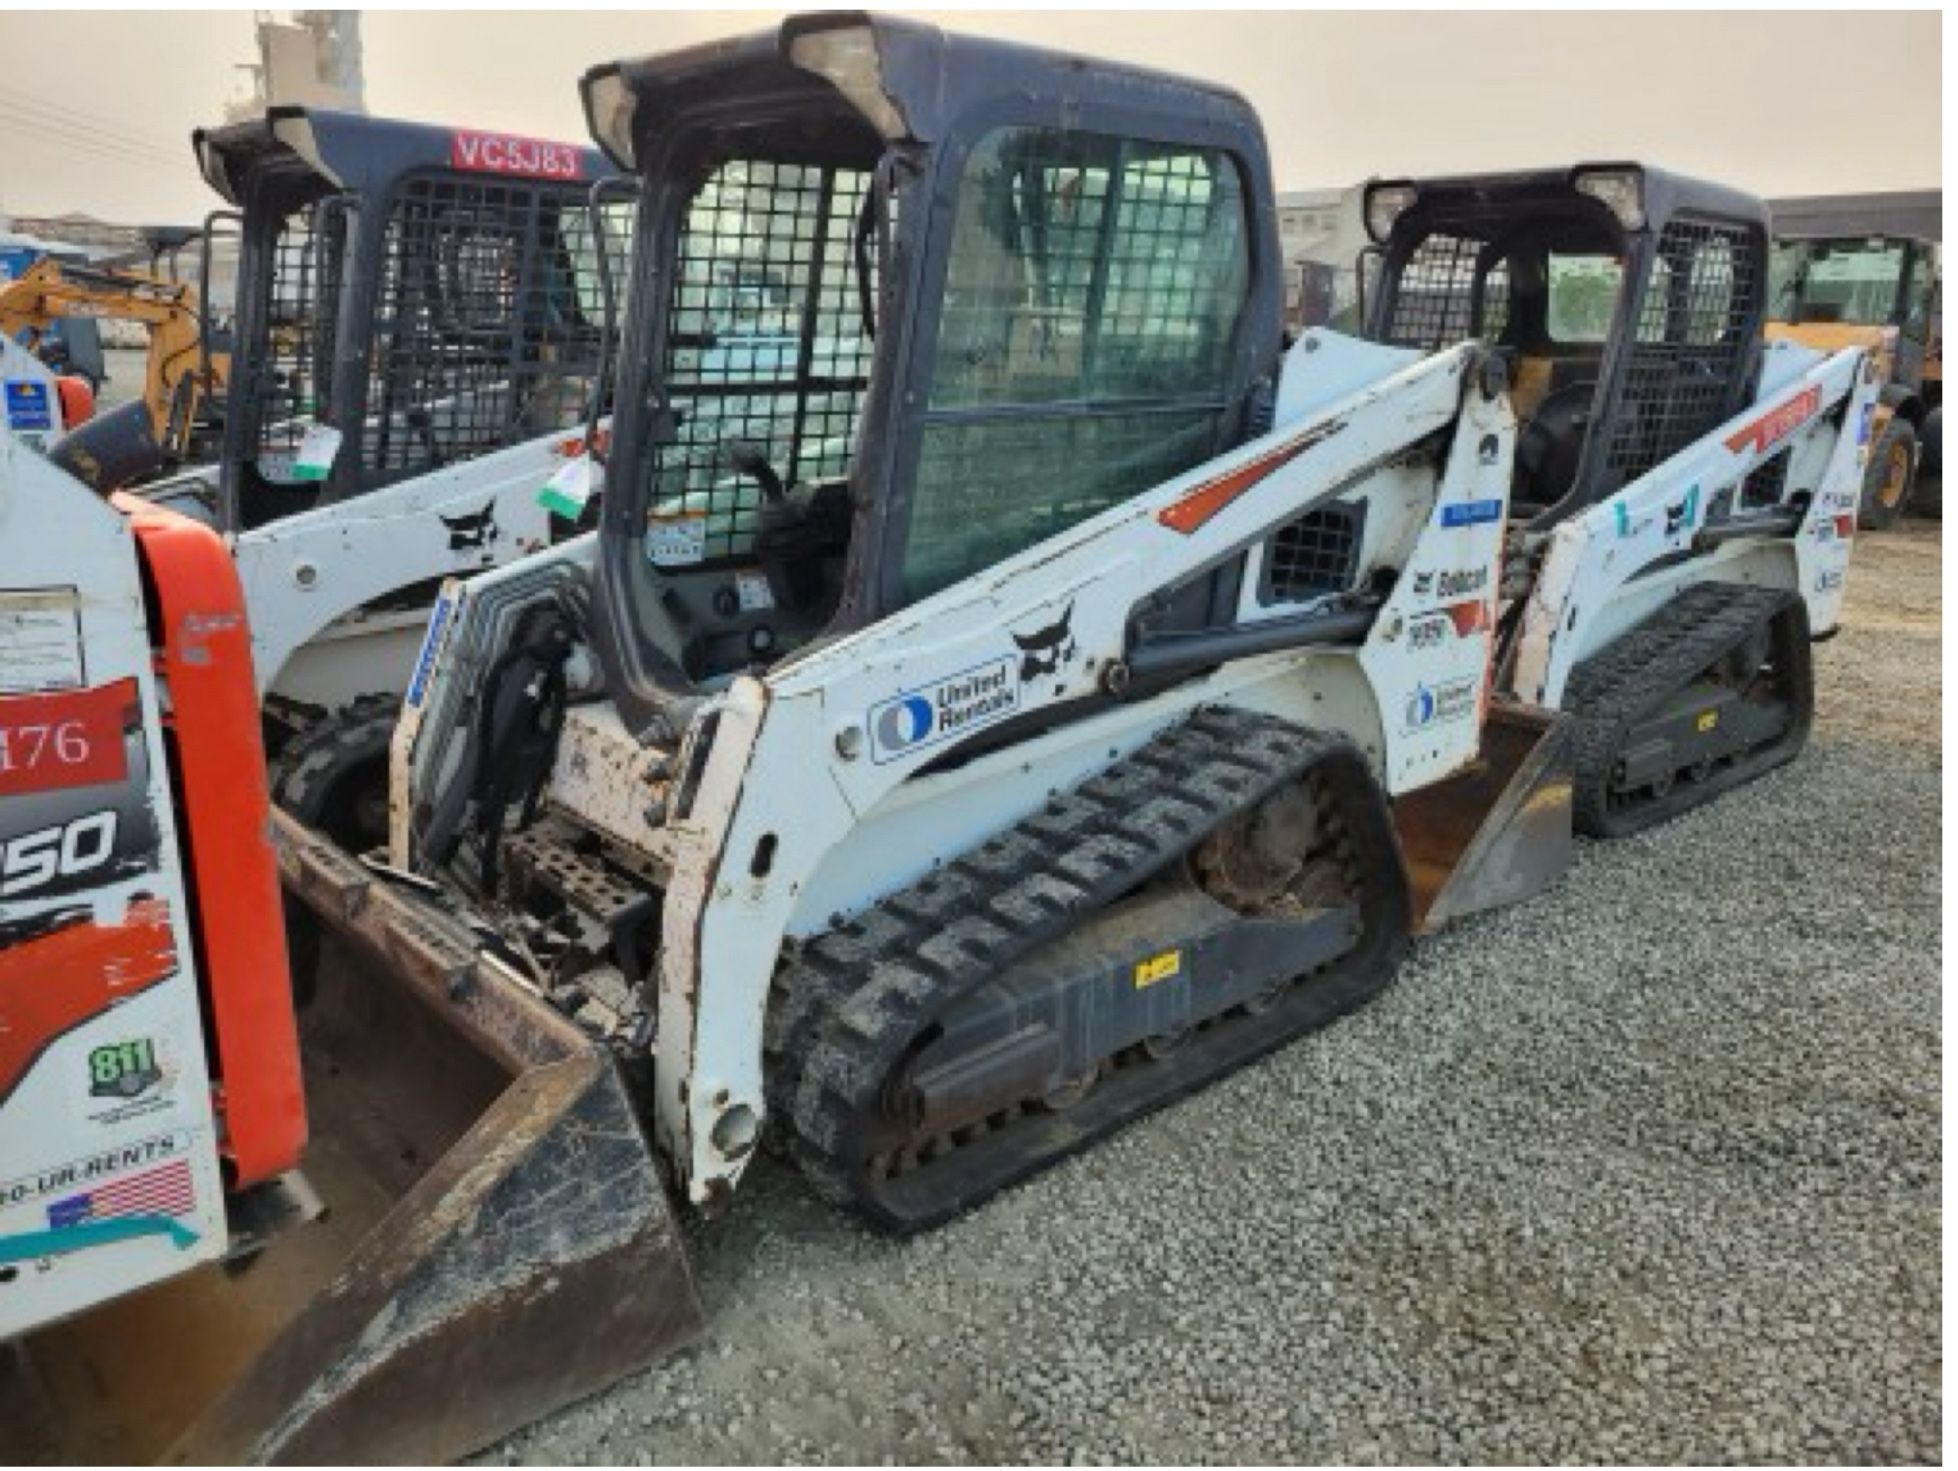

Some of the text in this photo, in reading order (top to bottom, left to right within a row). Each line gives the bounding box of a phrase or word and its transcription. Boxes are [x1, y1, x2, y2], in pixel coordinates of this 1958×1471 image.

[936, 664, 1007, 709] United
[939, 687, 1015, 731] Rentals
[0, 811, 117, 894] 50
[91, 1038, 154, 1083] 811
